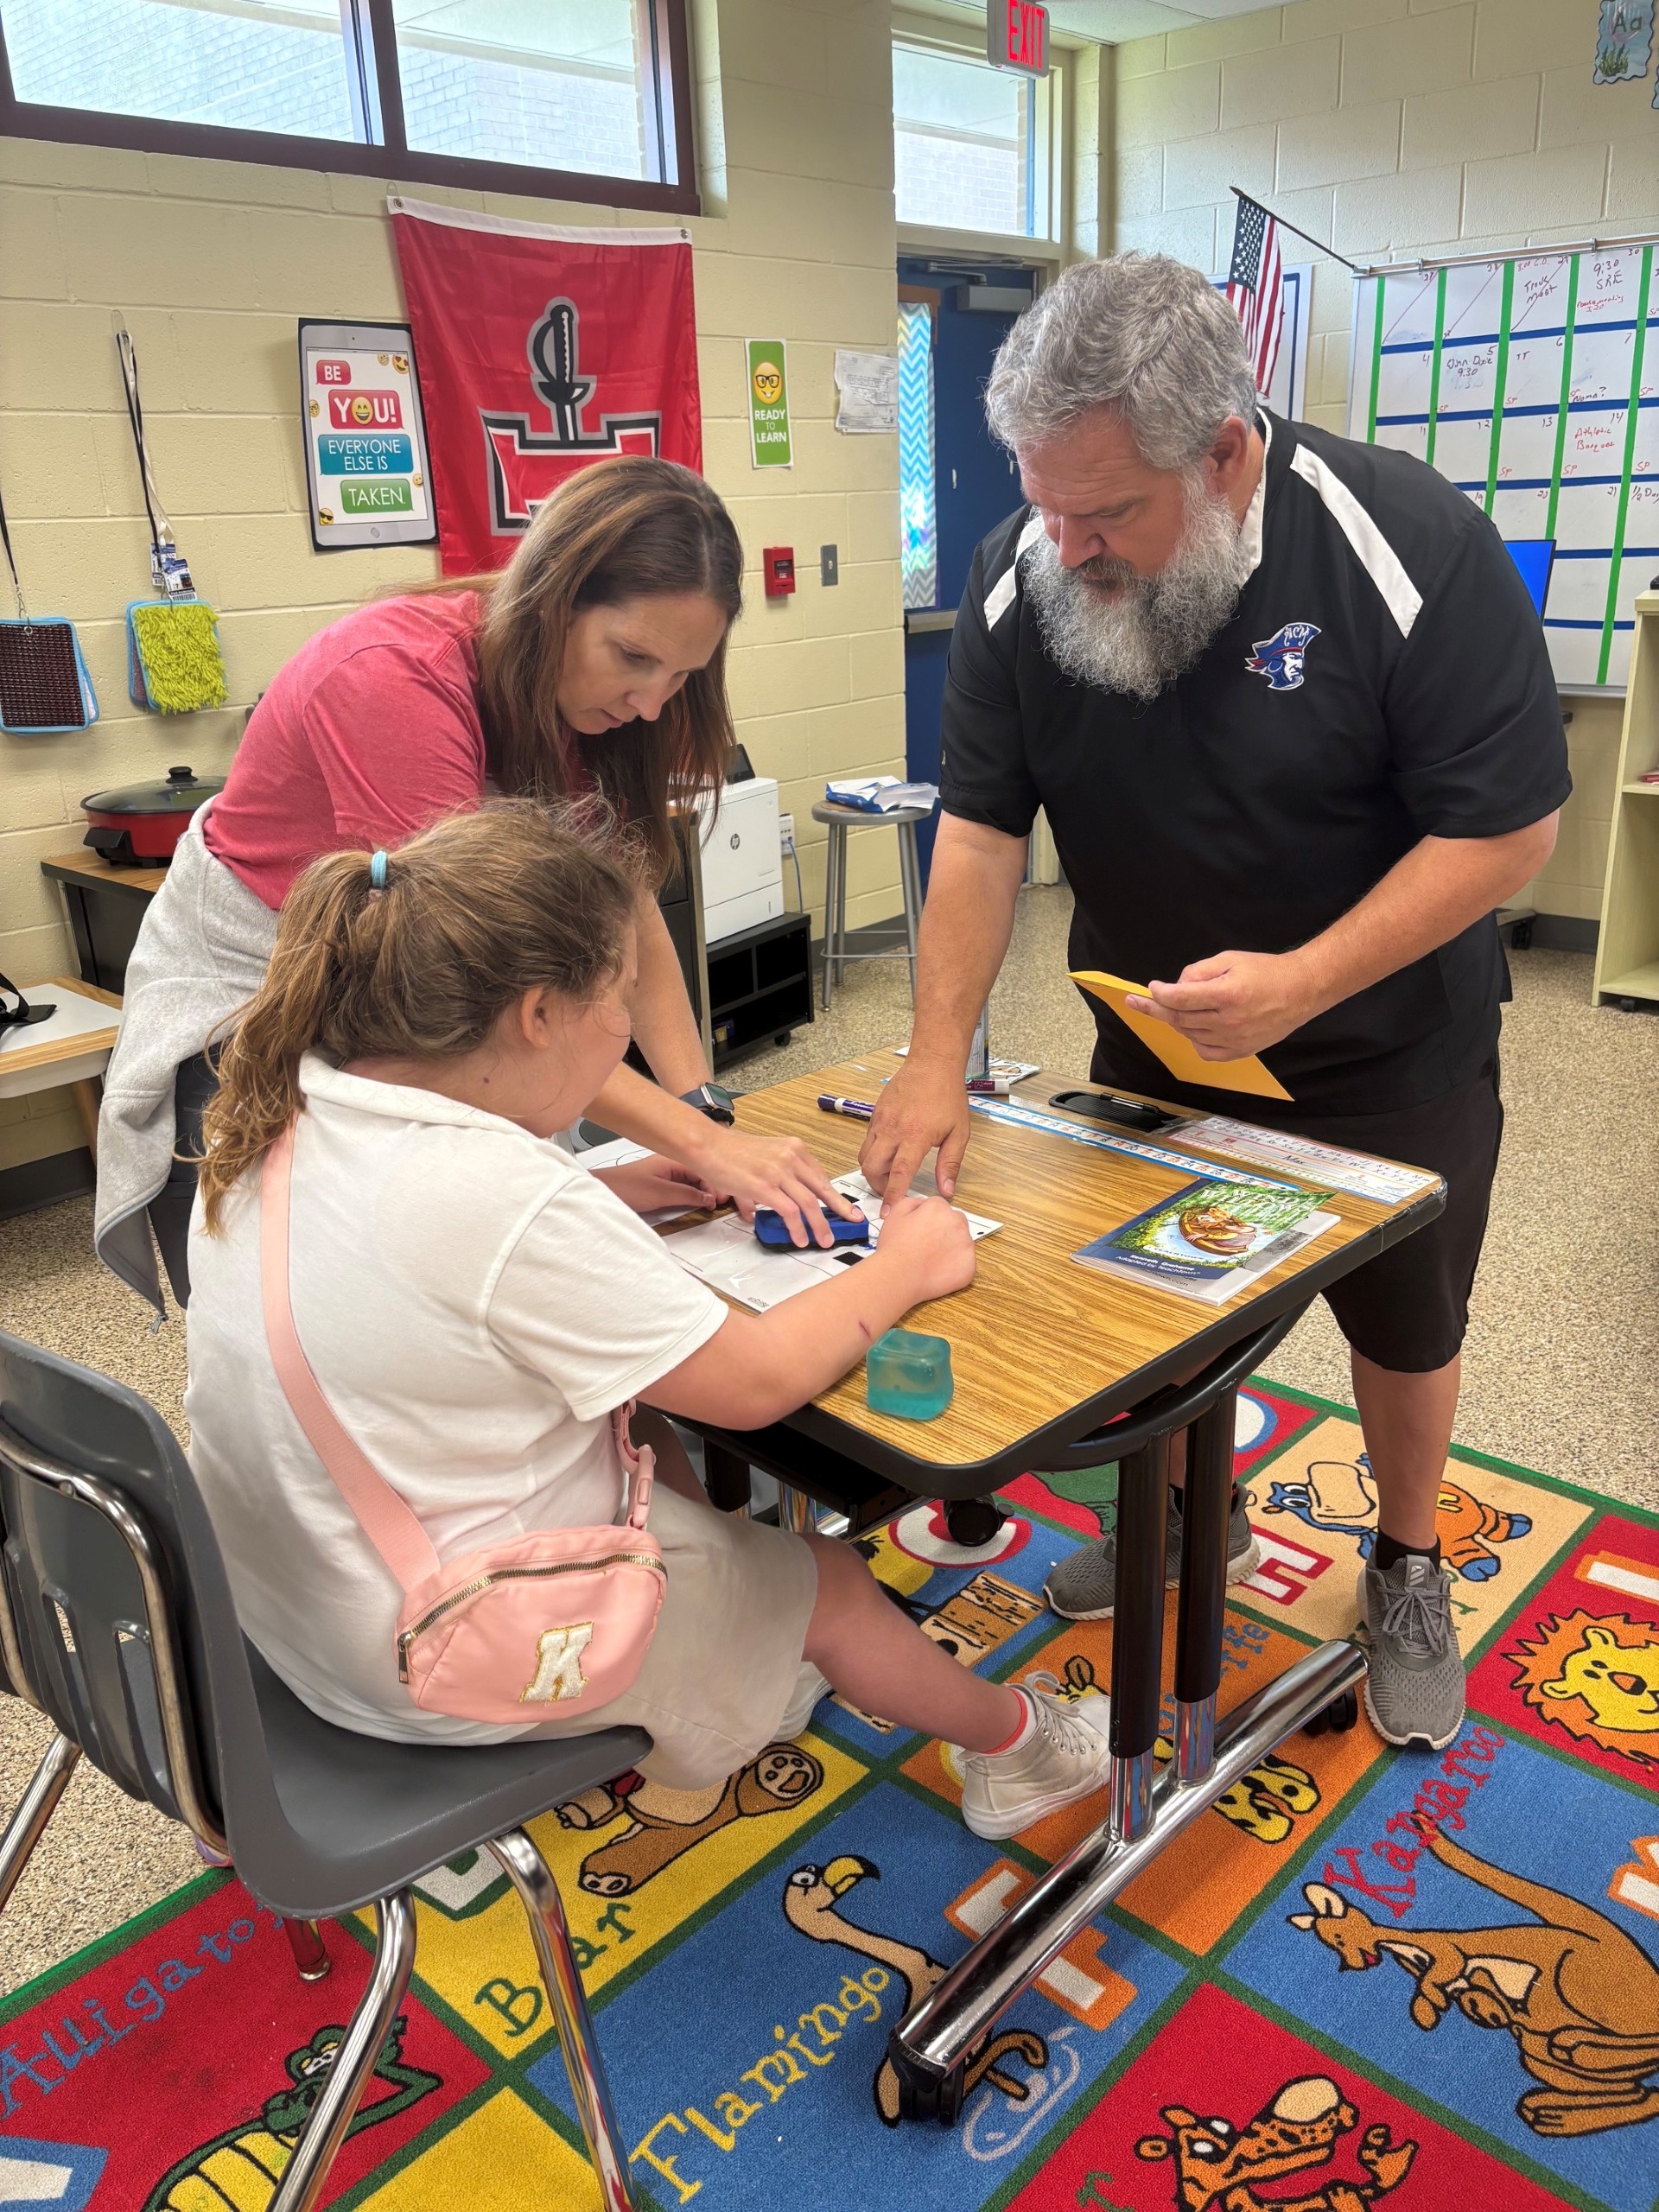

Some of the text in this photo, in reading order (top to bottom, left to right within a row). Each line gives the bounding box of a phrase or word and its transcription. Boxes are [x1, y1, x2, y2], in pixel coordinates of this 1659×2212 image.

[1611, 9, 1643, 35] Aa
[1007, 0, 1045, 70] EXIT
[1593, 259, 1619, 276] 9:30
[1556, 337, 1563, 346] 6
[1624, 333, 1632, 344] 7
[1487, 345, 1498, 355] 5
[1422, 354, 1430, 366] 4
[324, 365, 342, 381] BE
[1458, 368, 1478, 378] 9:30
[754, 409, 786, 421] READY
[1542, 416, 1553, 428] 13
[766, 422, 776, 430] TO
[756, 432, 787, 443] LEARN
[328, 439, 402, 454] EVERYONE
[344, 455, 389, 471] ELSE IS
[349, 487, 406, 507] TAKEN.
[519, 1621, 594, 1703] K
[1324, 1725, 1504, 1919] Kangaroo
[473, 1903, 635, 2037] Bar
[630, 1967, 889, 2204] Flamingo
